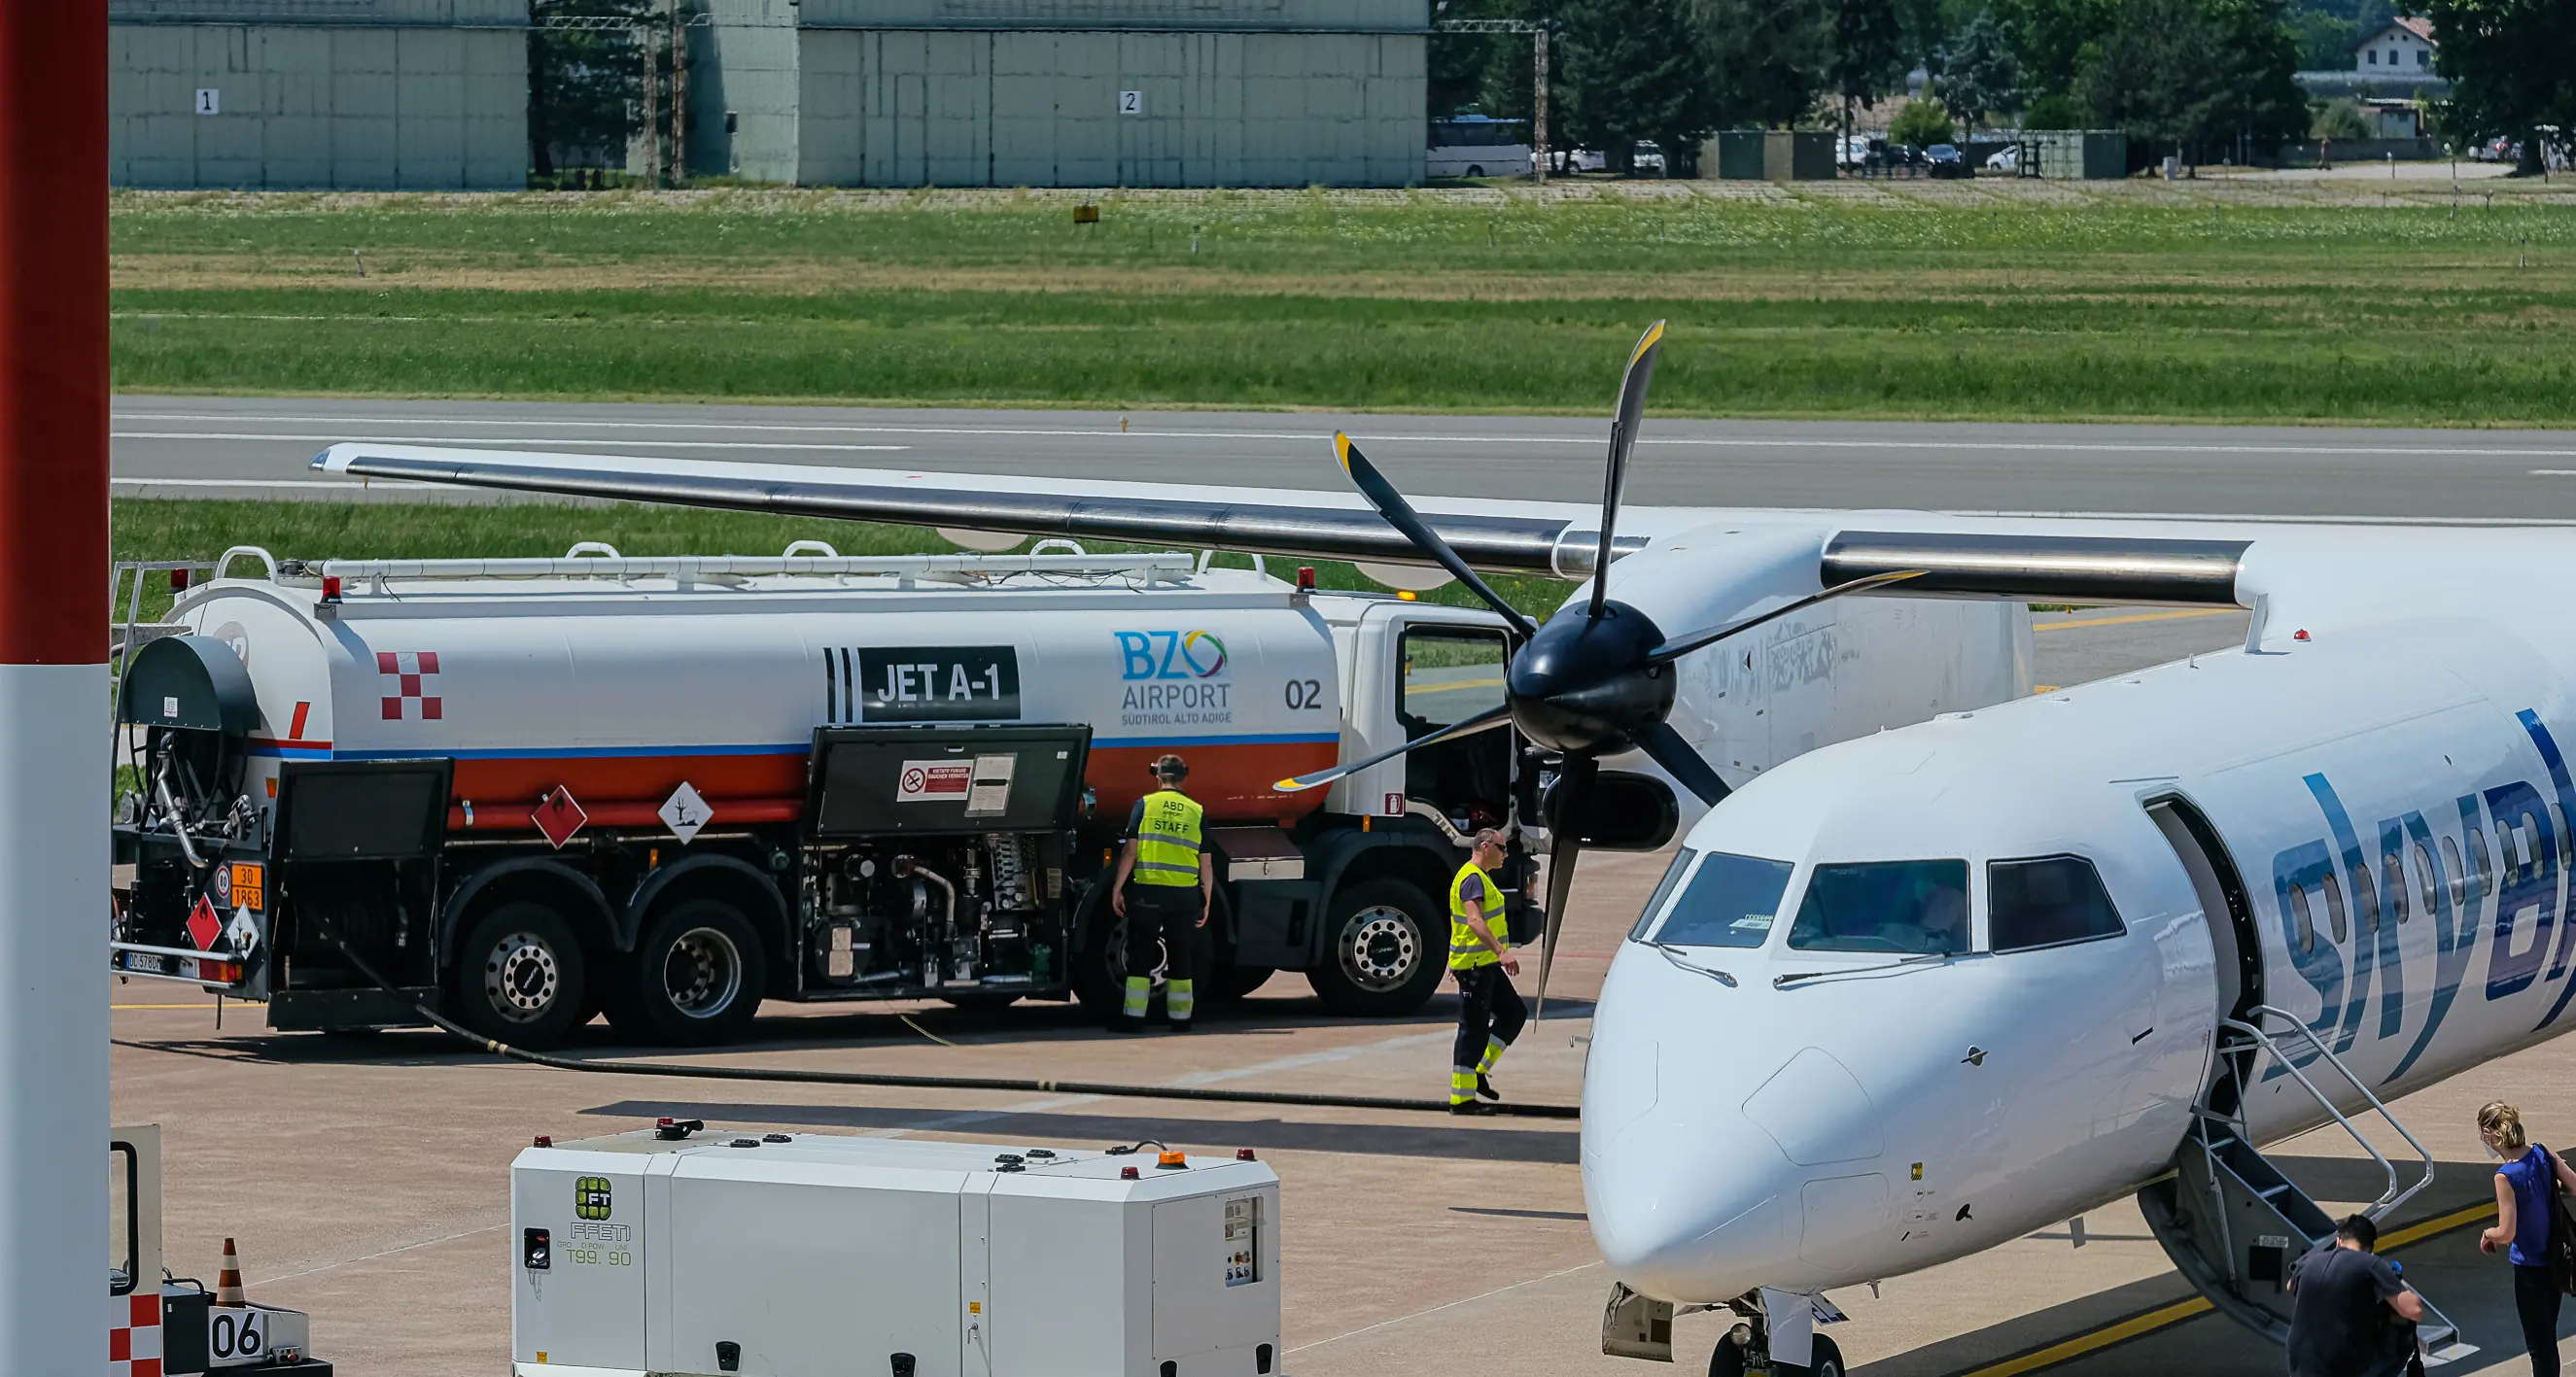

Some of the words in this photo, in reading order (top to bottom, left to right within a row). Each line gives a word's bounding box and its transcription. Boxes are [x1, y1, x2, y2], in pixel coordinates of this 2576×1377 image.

[202, 91, 212, 111] 1
[1126, 92, 1135, 111] 2
[1114, 630, 1229, 680] BZO
[877, 664, 938, 703] JET
[948, 663, 1000, 702] A-1
[1122, 683, 1232, 710] AIRPORT
[1285, 679, 1322, 710] 02
[1122, 712, 1172, 727] SÜDTIROL
[1174, 712, 1200, 724] ALTO
[1201, 711, 1233, 724] ADIGE
[1163, 800, 1184, 811] ABD
[1155, 820, 1189, 834] STAFF
[241, 868, 253, 884] 30
[235, 888, 260, 907] 1863
[588, 1192, 610, 1206] FT
[556, 1240, 573, 1249] GRO
[609, 1251, 632, 1267] 90
[212, 1312, 261, 1359] 06
